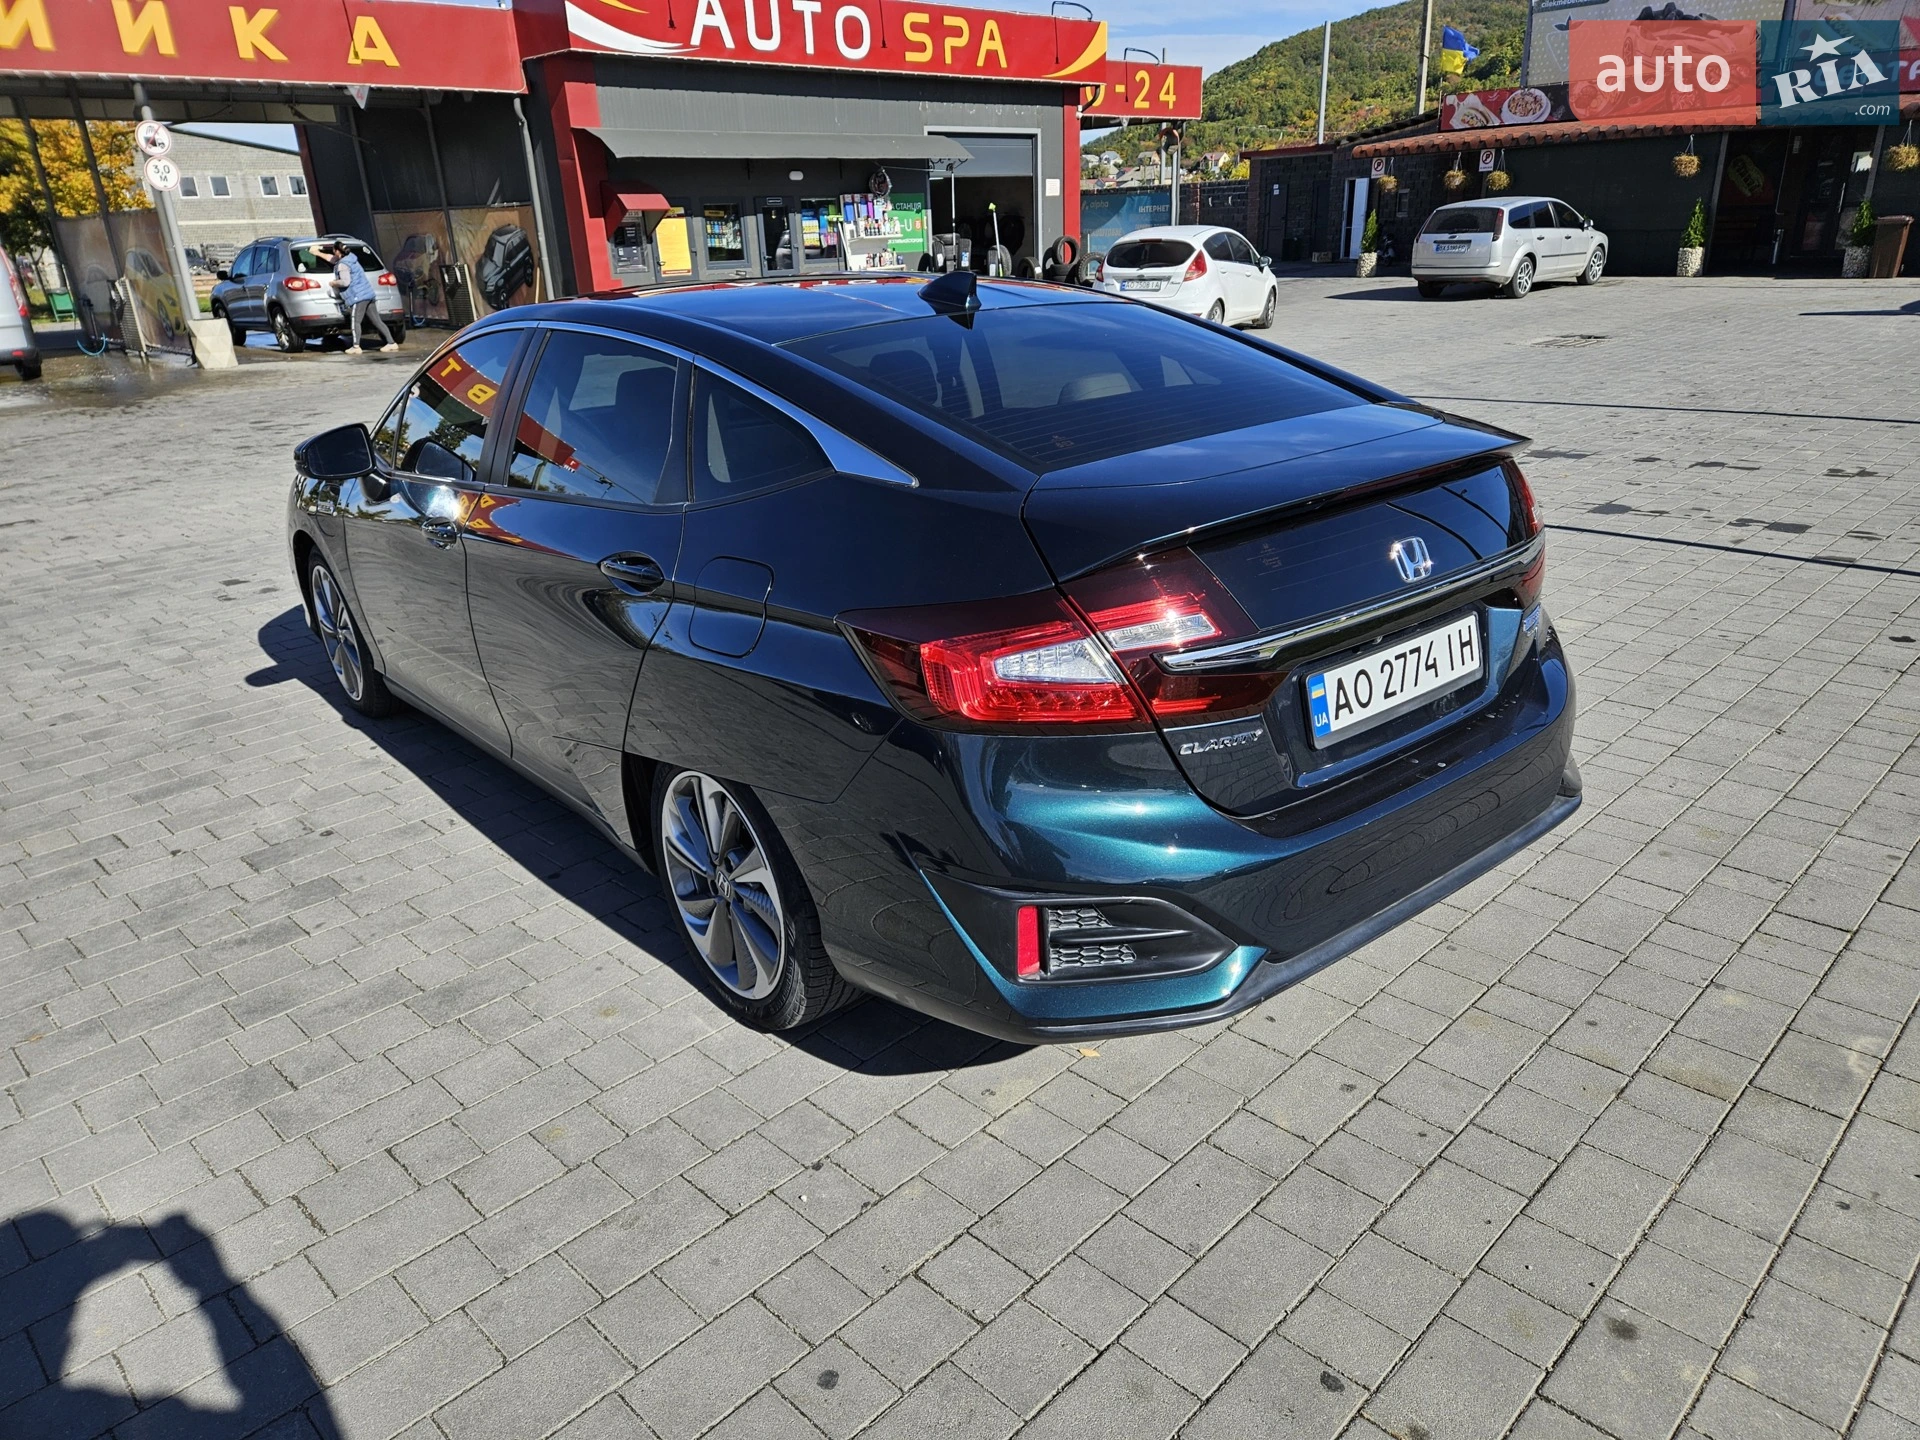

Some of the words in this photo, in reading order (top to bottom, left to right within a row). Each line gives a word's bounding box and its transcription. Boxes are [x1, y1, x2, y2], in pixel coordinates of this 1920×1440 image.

[690, 0, 871, 60] AUTO
[903, 12, 1007, 68] SPA
[1138, 204, 1169, 213] ІНТЕРНЕТ
[1334, 668, 1373, 721] AO
[1380, 640, 1439, 700] 2774
[1447, 624, 1474, 672] IH
[1314, 711, 1329, 727] UA
[1180, 729, 1263, 755] CLARITY
